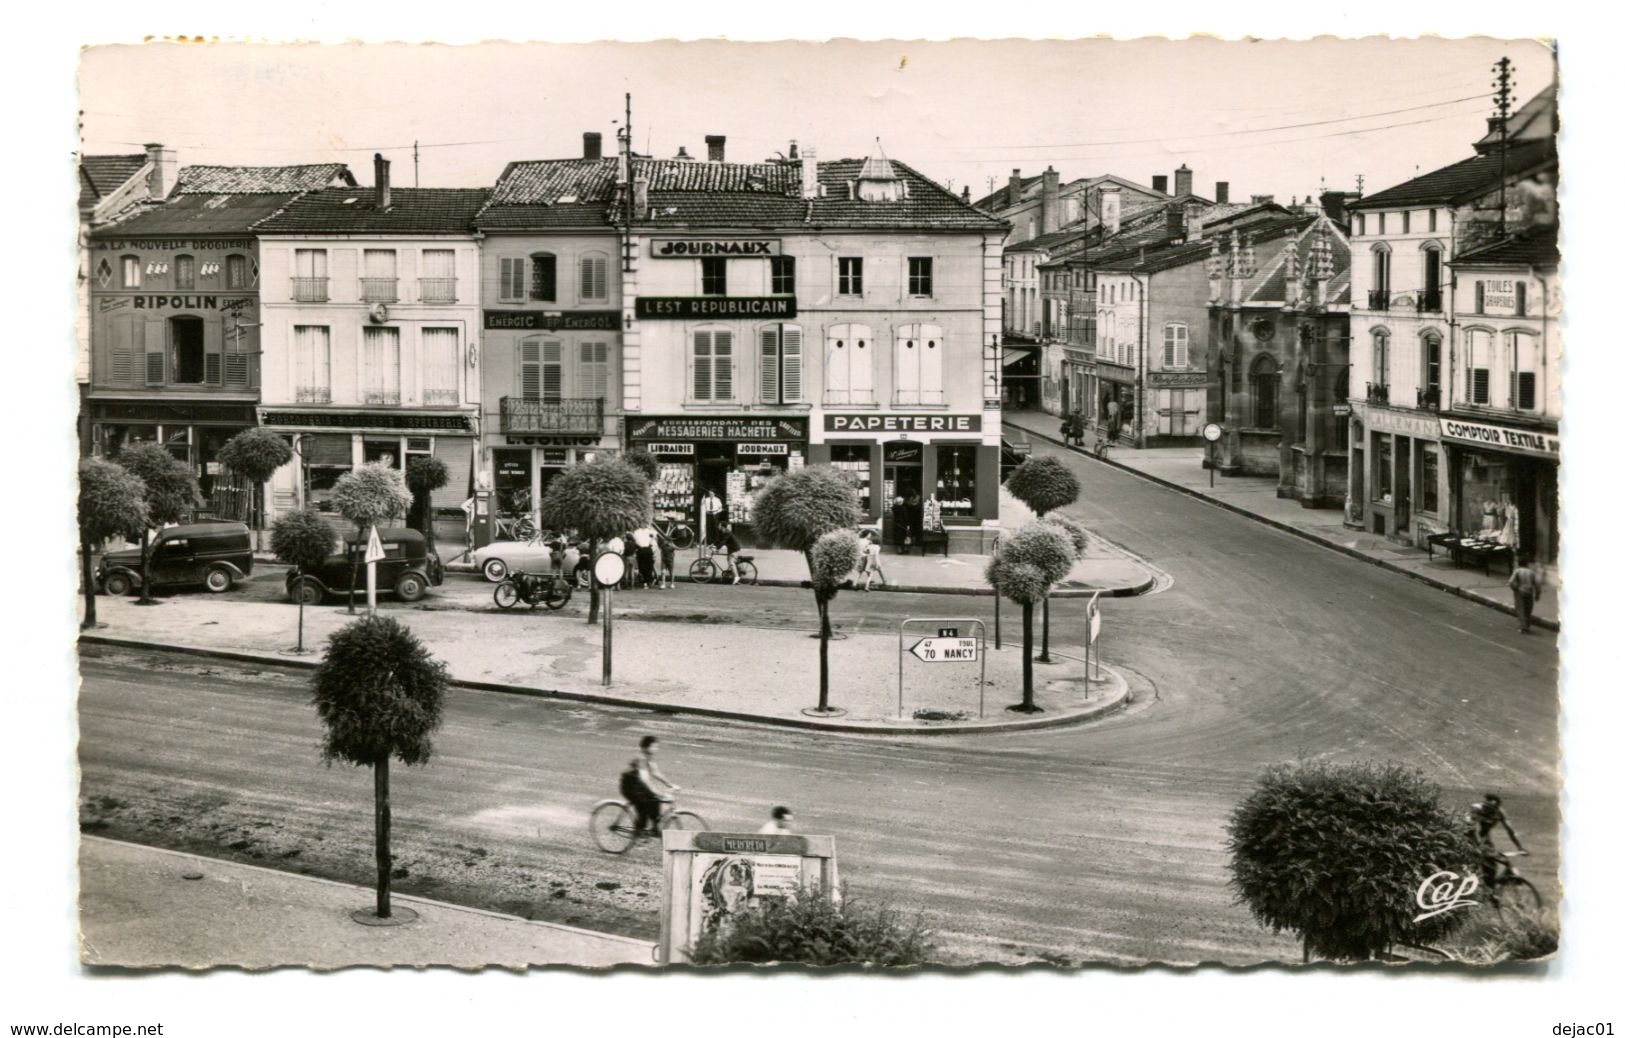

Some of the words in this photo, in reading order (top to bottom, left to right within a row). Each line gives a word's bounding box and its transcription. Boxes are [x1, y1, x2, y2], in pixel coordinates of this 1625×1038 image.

[111, 240, 126, 250] LA
[130, 240, 187, 250] NOUVELLE
[192, 240, 252, 250] DROGUERIE
[660, 242, 772, 255] JOURNAUX
[133, 295, 218, 309] RIPOLIN
[834, 416, 970, 430] PAPETERIE
[657, 426, 724, 437] MESSAGERIES
[728, 426, 777, 437] HACHETTE
[1446, 422, 1501, 444] COMPTOIR
[1503, 429, 1546, 450] TEXTILE
[650, 445, 693, 454] LIBRAIRIE
[739, 445, 785, 454] JOURNAUX
[959, 640, 974, 648] TOUL
[925, 649, 936, 659] 70
[944, 649, 974, 659] NANCY
